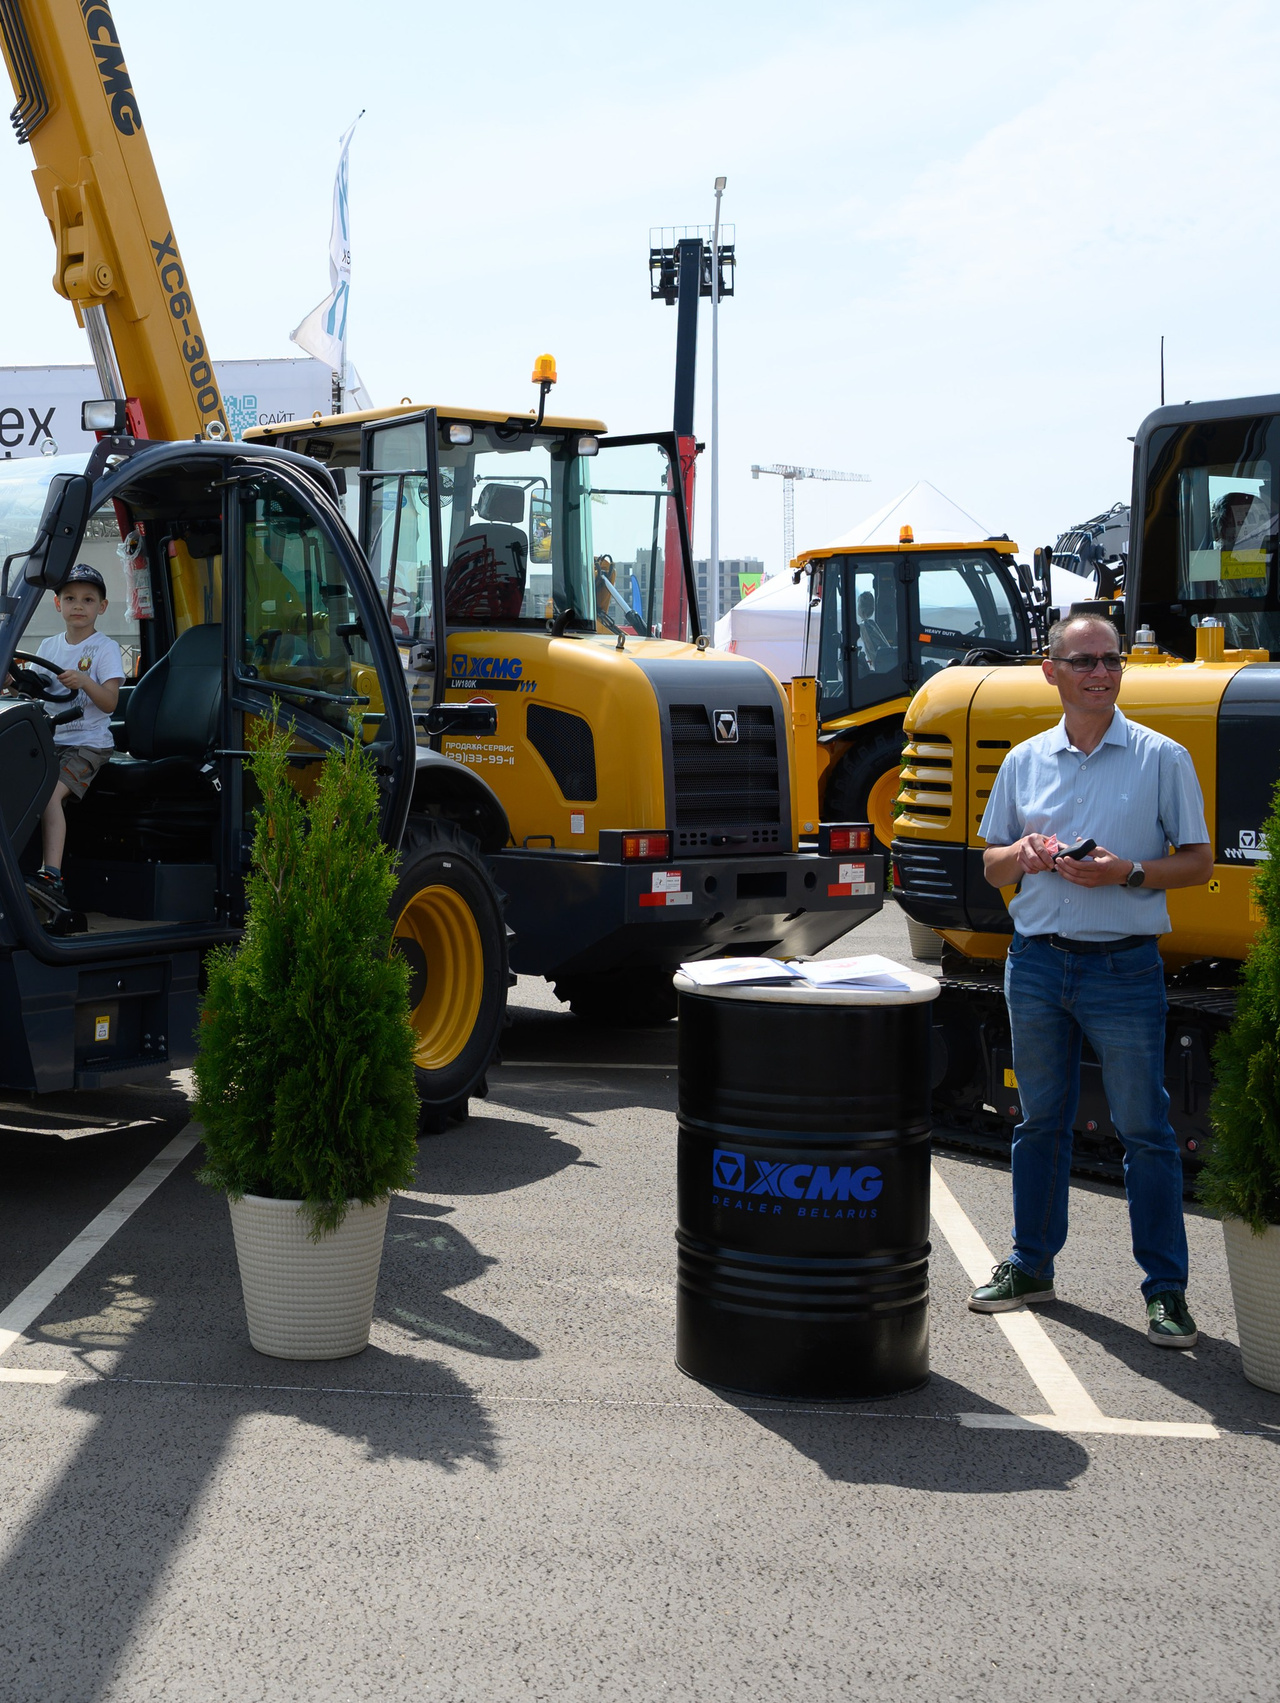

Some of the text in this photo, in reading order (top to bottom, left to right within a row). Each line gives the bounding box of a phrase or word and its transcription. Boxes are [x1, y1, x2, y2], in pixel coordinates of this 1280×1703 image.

[258, 410, 295, 426] САЙТ
[467, 657, 523, 680] XCMG
[451, 679, 477, 689] LW180K
[745, 1160, 883, 1202] XCMG
[712, 1195, 878, 1219] DEALER BELARUS
